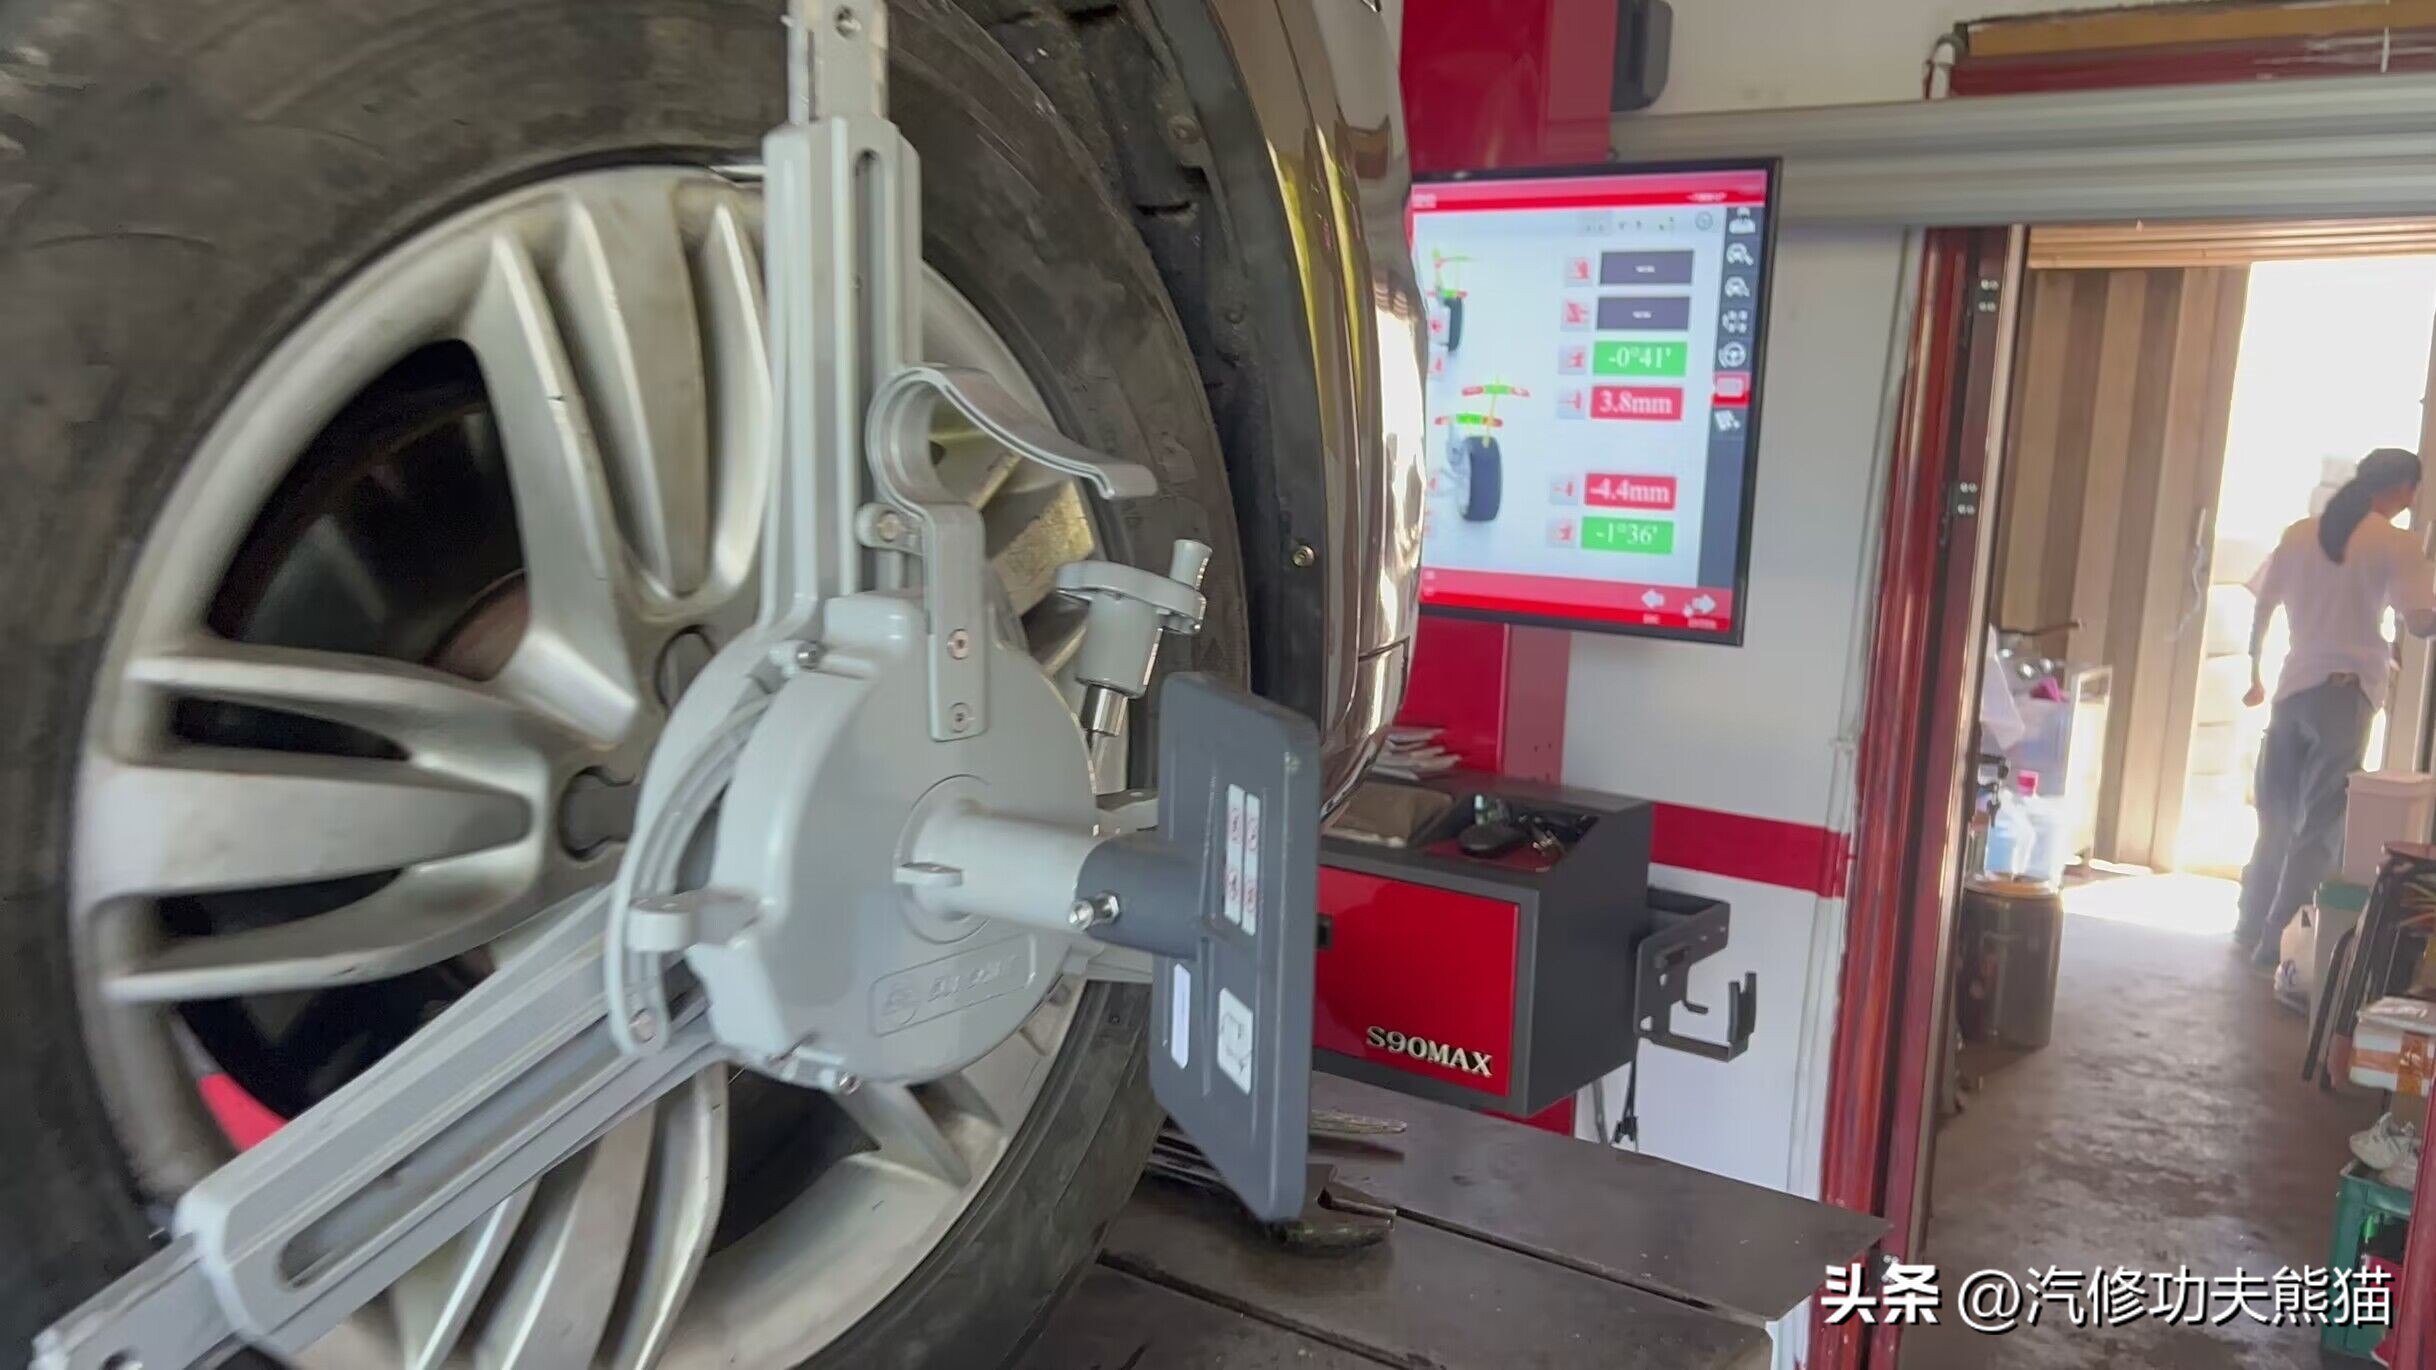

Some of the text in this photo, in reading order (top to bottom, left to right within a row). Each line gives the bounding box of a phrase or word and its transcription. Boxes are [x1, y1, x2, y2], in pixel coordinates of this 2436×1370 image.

[1600, 389, 1673, 415] 3.8mm
[1590, 477, 1671, 504] -4.4mm
[1366, 1025, 1493, 1078] S90MAX
